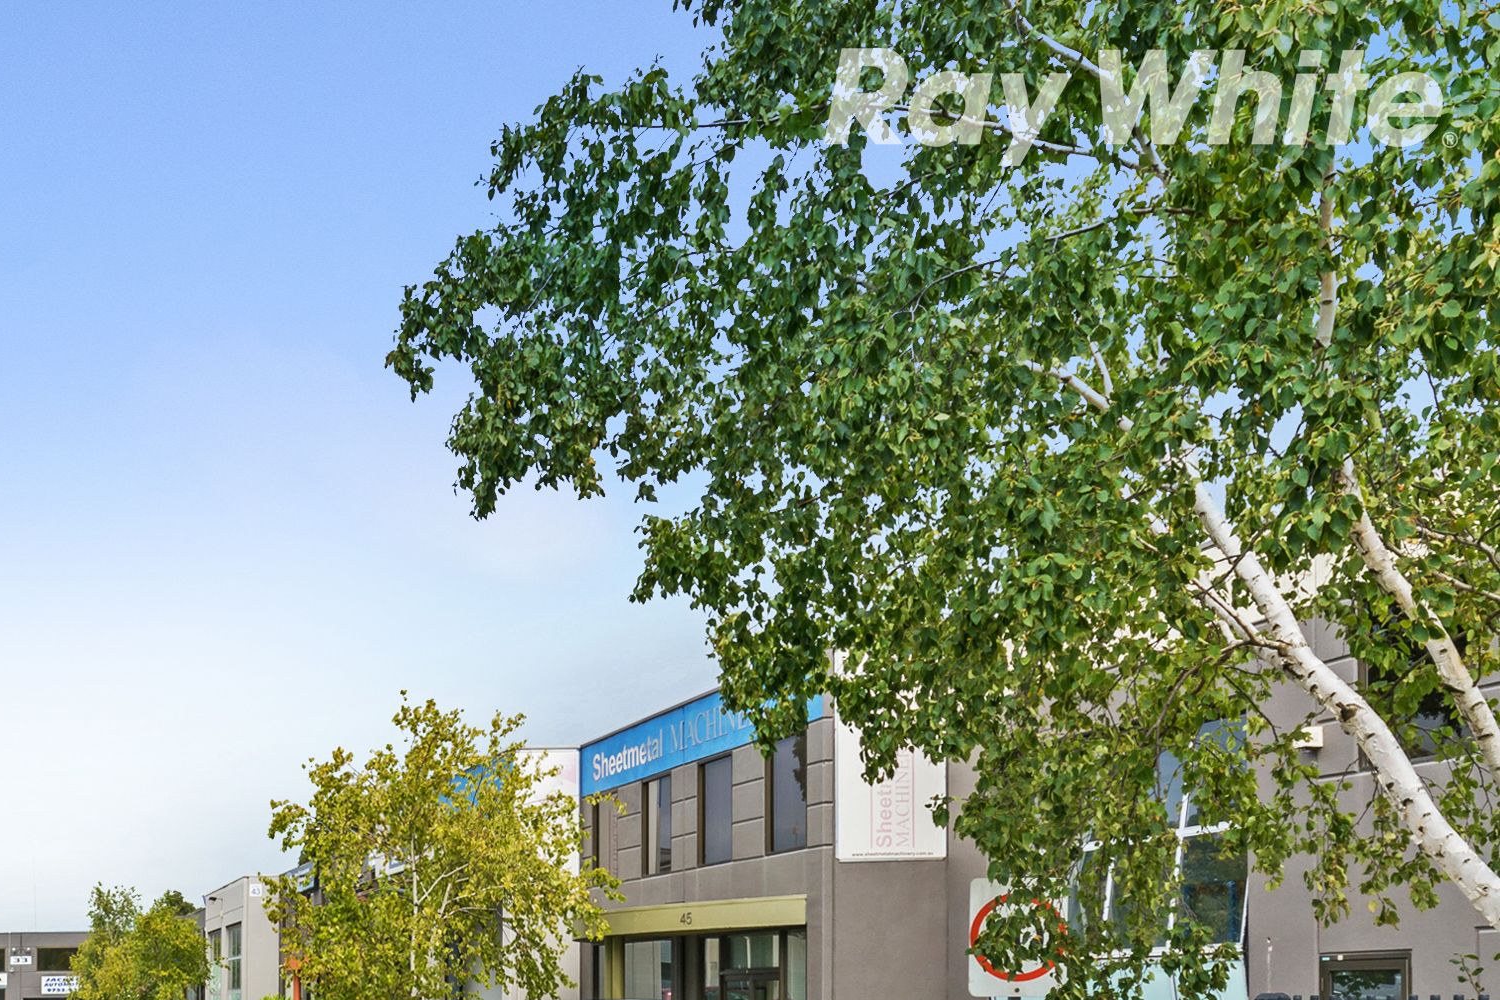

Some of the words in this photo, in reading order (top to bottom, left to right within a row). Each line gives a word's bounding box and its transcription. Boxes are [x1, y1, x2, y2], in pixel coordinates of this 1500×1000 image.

[592, 730, 663, 781] Sheetmetal
[670, 704, 755, 751] MACHINE
[680, 912, 692, 925] 45
